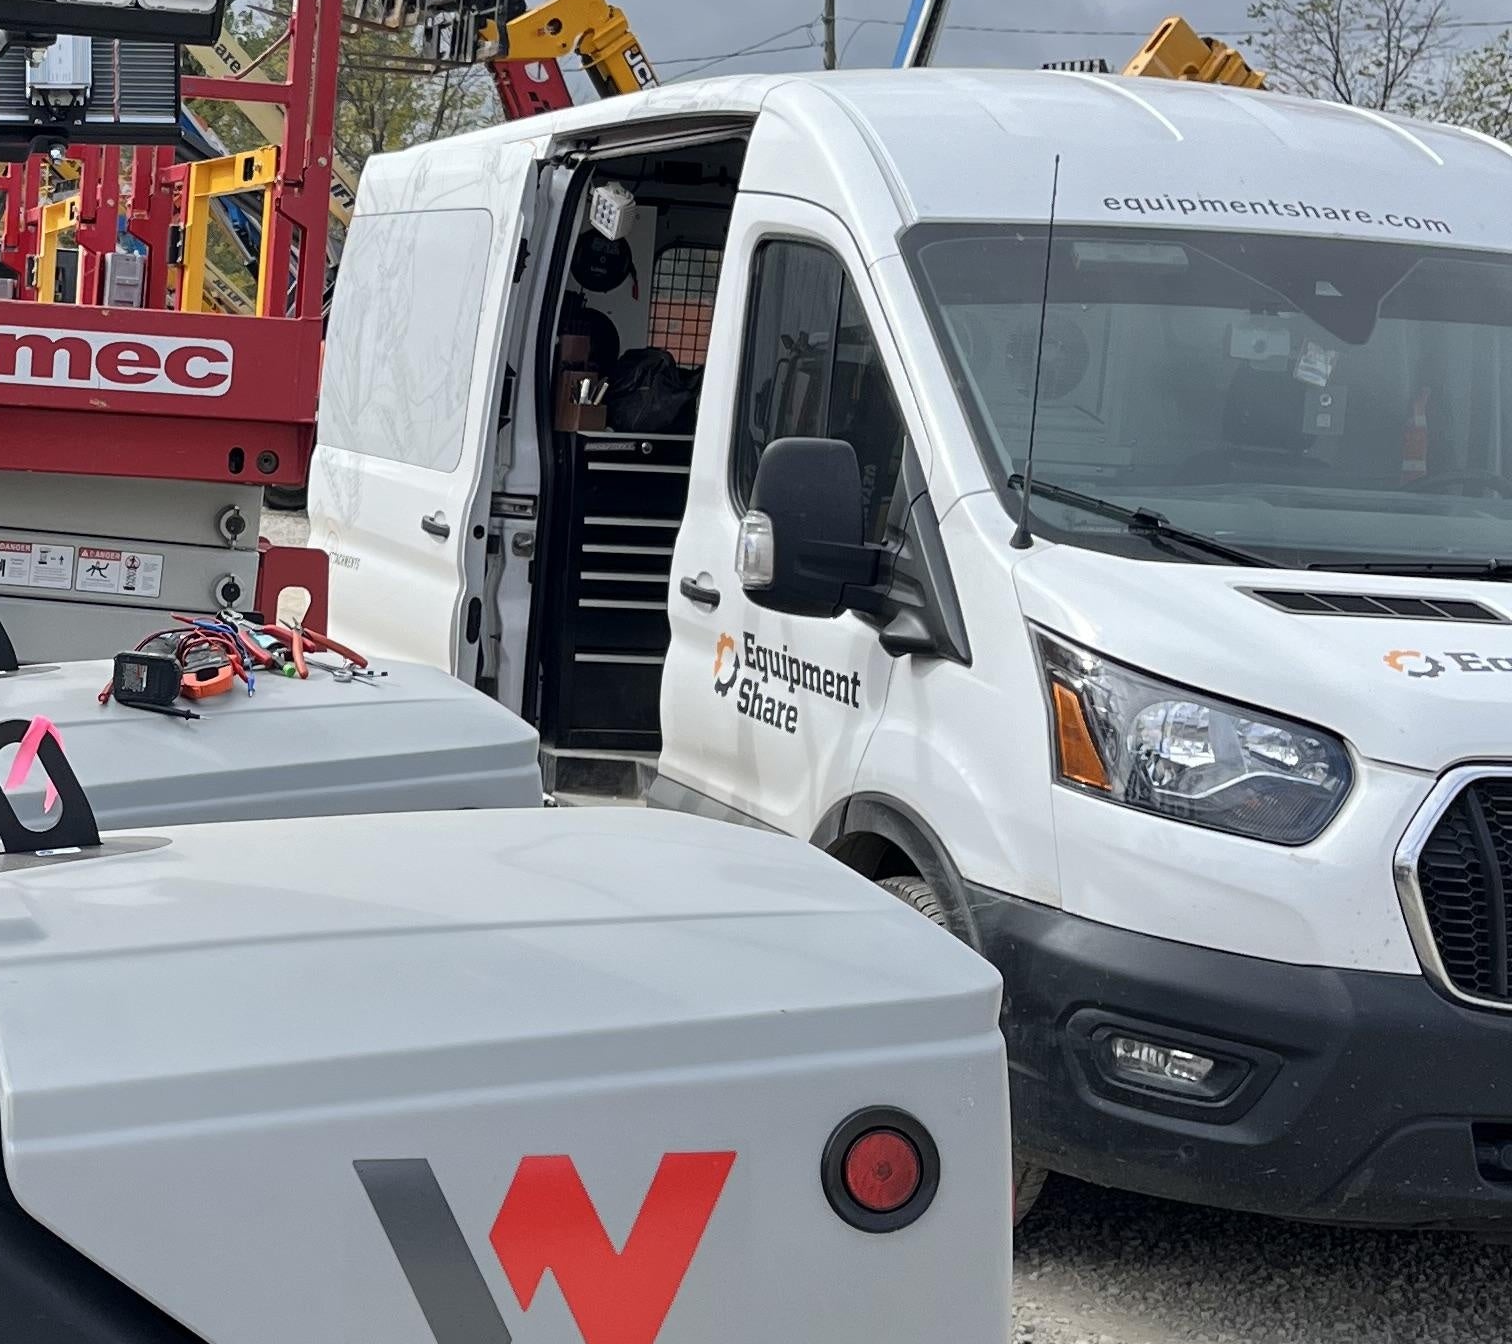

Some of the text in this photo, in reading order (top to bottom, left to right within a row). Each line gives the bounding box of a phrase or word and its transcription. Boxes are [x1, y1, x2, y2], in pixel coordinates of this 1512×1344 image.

[1104, 193, 1452, 234] equipmentshare.com
[0, 543, 31, 552] DANGER
[89, 551, 121, 560] DANGER
[743, 631, 861, 708] Equipment
[737, 677, 798, 734] Share
